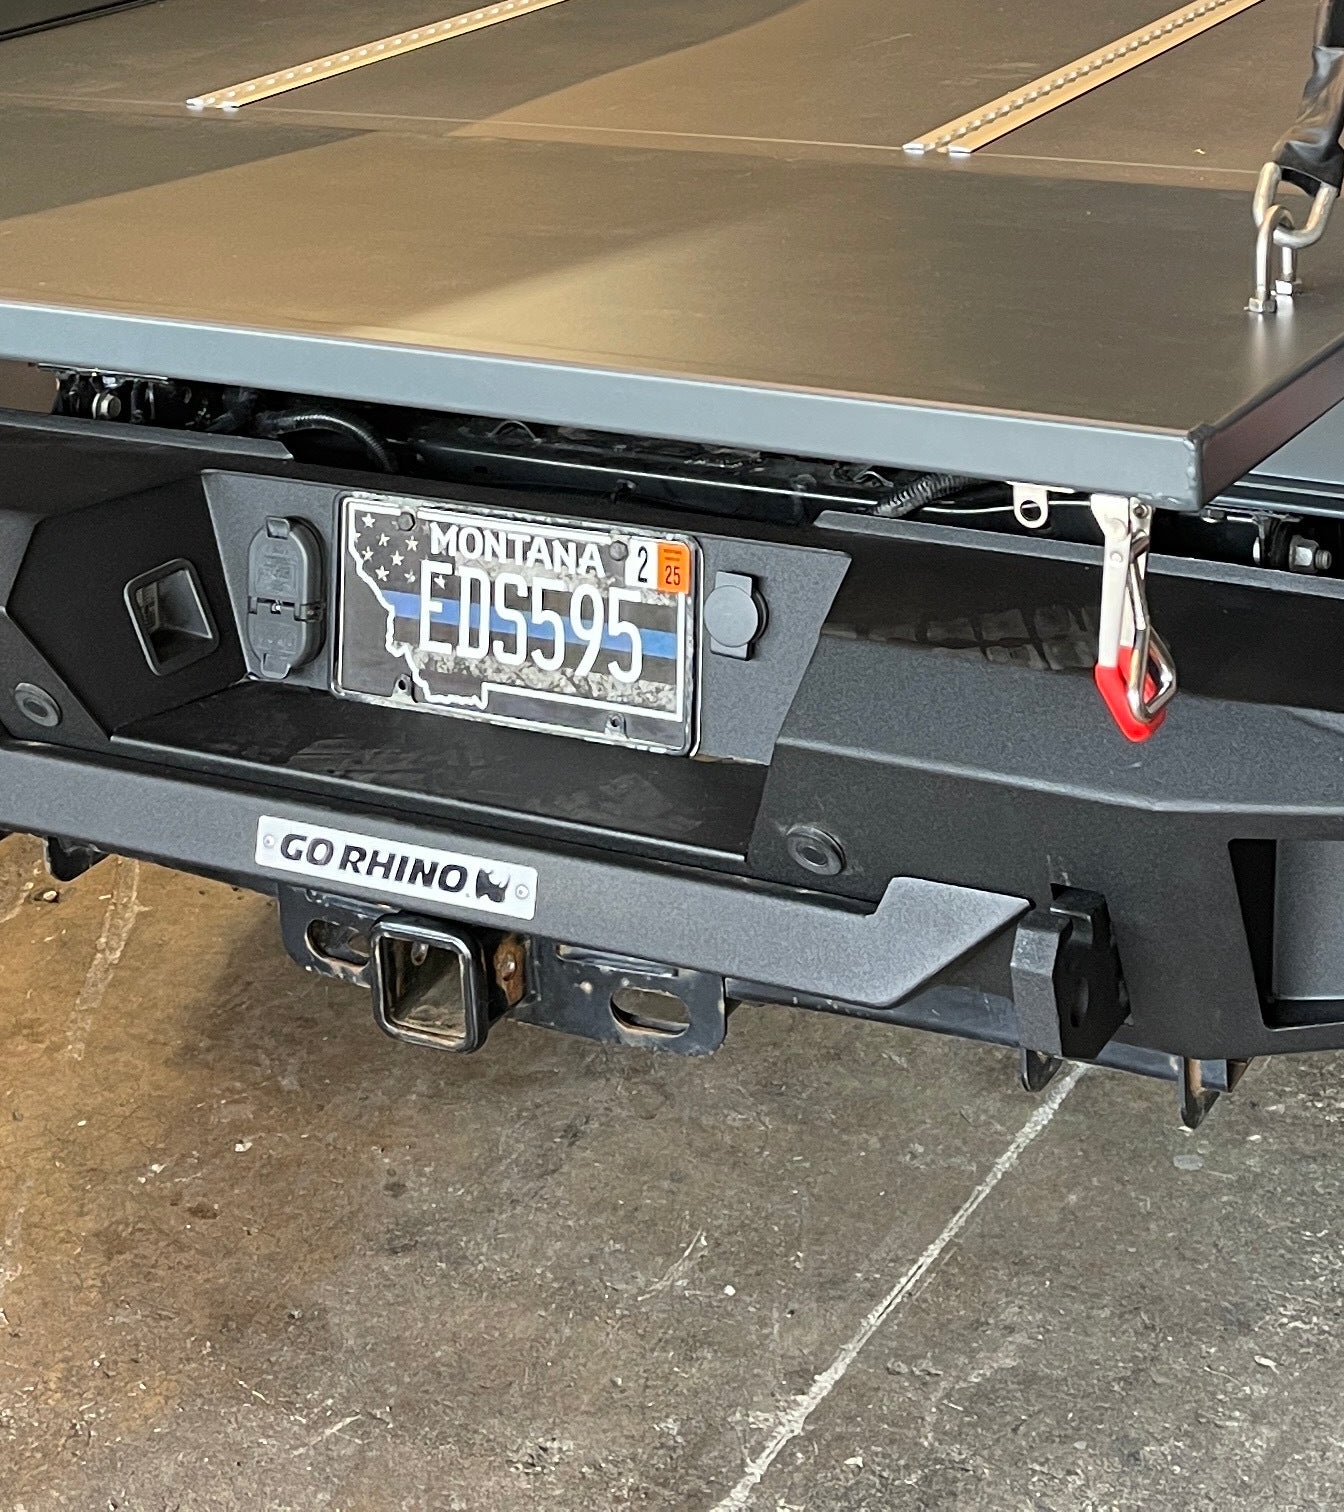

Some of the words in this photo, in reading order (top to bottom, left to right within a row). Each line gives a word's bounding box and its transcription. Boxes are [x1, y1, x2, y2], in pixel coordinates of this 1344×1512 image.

[429, 522, 607, 579] MONTANA
[637, 545, 648, 583] 2
[665, 565, 681, 586] 25
[419, 560, 644, 685] EDS595
[280, 833, 334, 867] GO
[338, 844, 468, 894] RHINO
